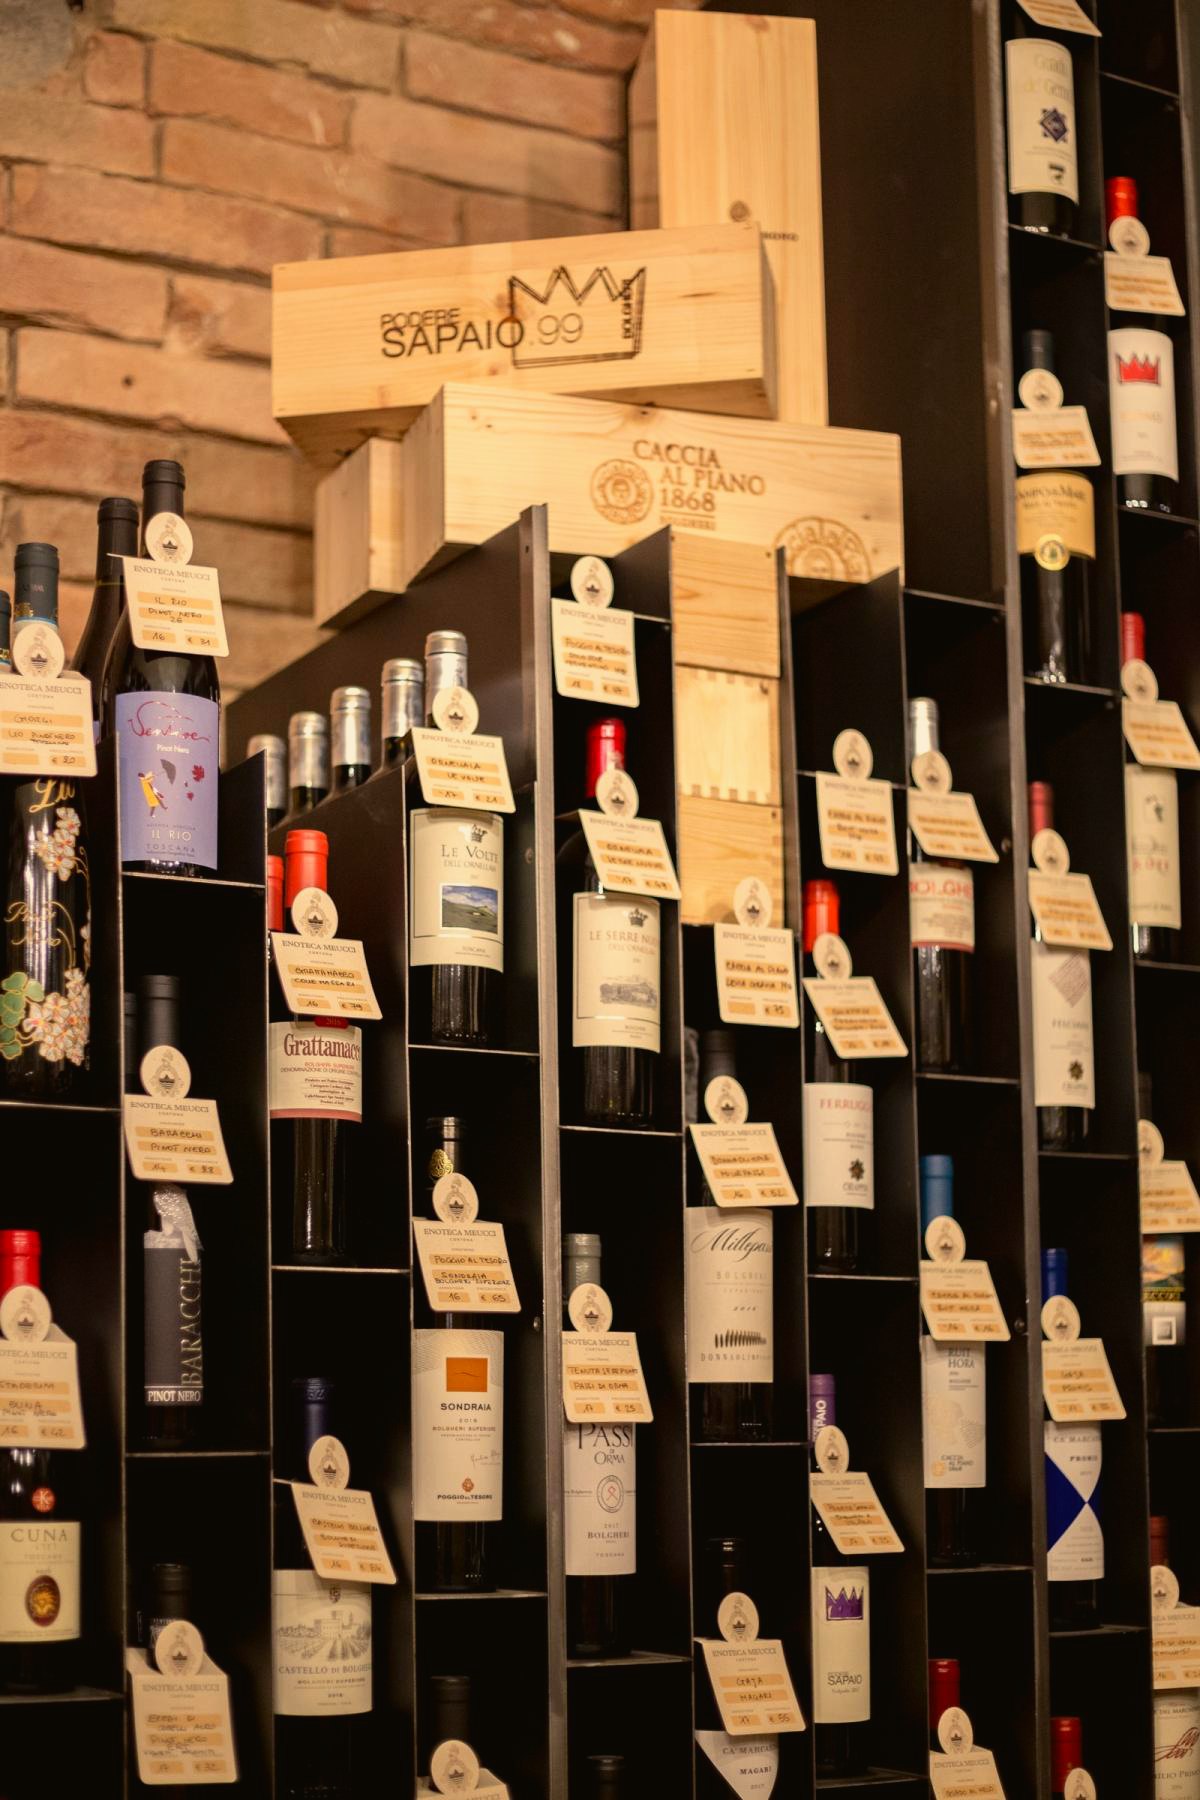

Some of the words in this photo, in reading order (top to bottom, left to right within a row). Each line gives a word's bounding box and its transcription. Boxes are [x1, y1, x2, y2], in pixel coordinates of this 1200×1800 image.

[381, 308, 461, 329] PODERE
[382, 316, 525, 358] SAPAIO
[632, 438, 721, 469] CACCIA
[660, 466, 692, 487] AL
[693, 470, 767, 497] PIANO
[659, 487, 717, 512] 1868
[134, 565, 175, 577] ENOTECA
[176, 570, 211, 581] MEUCCI
[45, 684, 82, 695] MEUCCI
[169, 831, 192, 842] RIO
[282, 941, 321, 951] ENOTECA
[323, 944, 356, 953] MEUCCI
[130, 1101, 173, 1111] ENOTECA
[174, 1104, 209, 1113] MEUCCI
[424, 1228, 462, 1237] ENOTECA
[465, 1229, 496, 1237] MEUCCI
[180, 1258, 203, 1386] BARACCHI
[32, 1351, 67, 1360] MEUCCI
[148, 1391, 176, 1402] PINOT
[177, 1391, 200, 1402] NERO
[440, 1403, 492, 1411] SONDRAIA
[594, 1451, 626, 1465] ORMA
[10, 1529, 68, 1542] CUNA
[712, 1649, 746, 1657] ENOTECA
[279, 1665, 328, 1675] CASTELLO
[828, 1675, 862, 1686] SAPAIO
